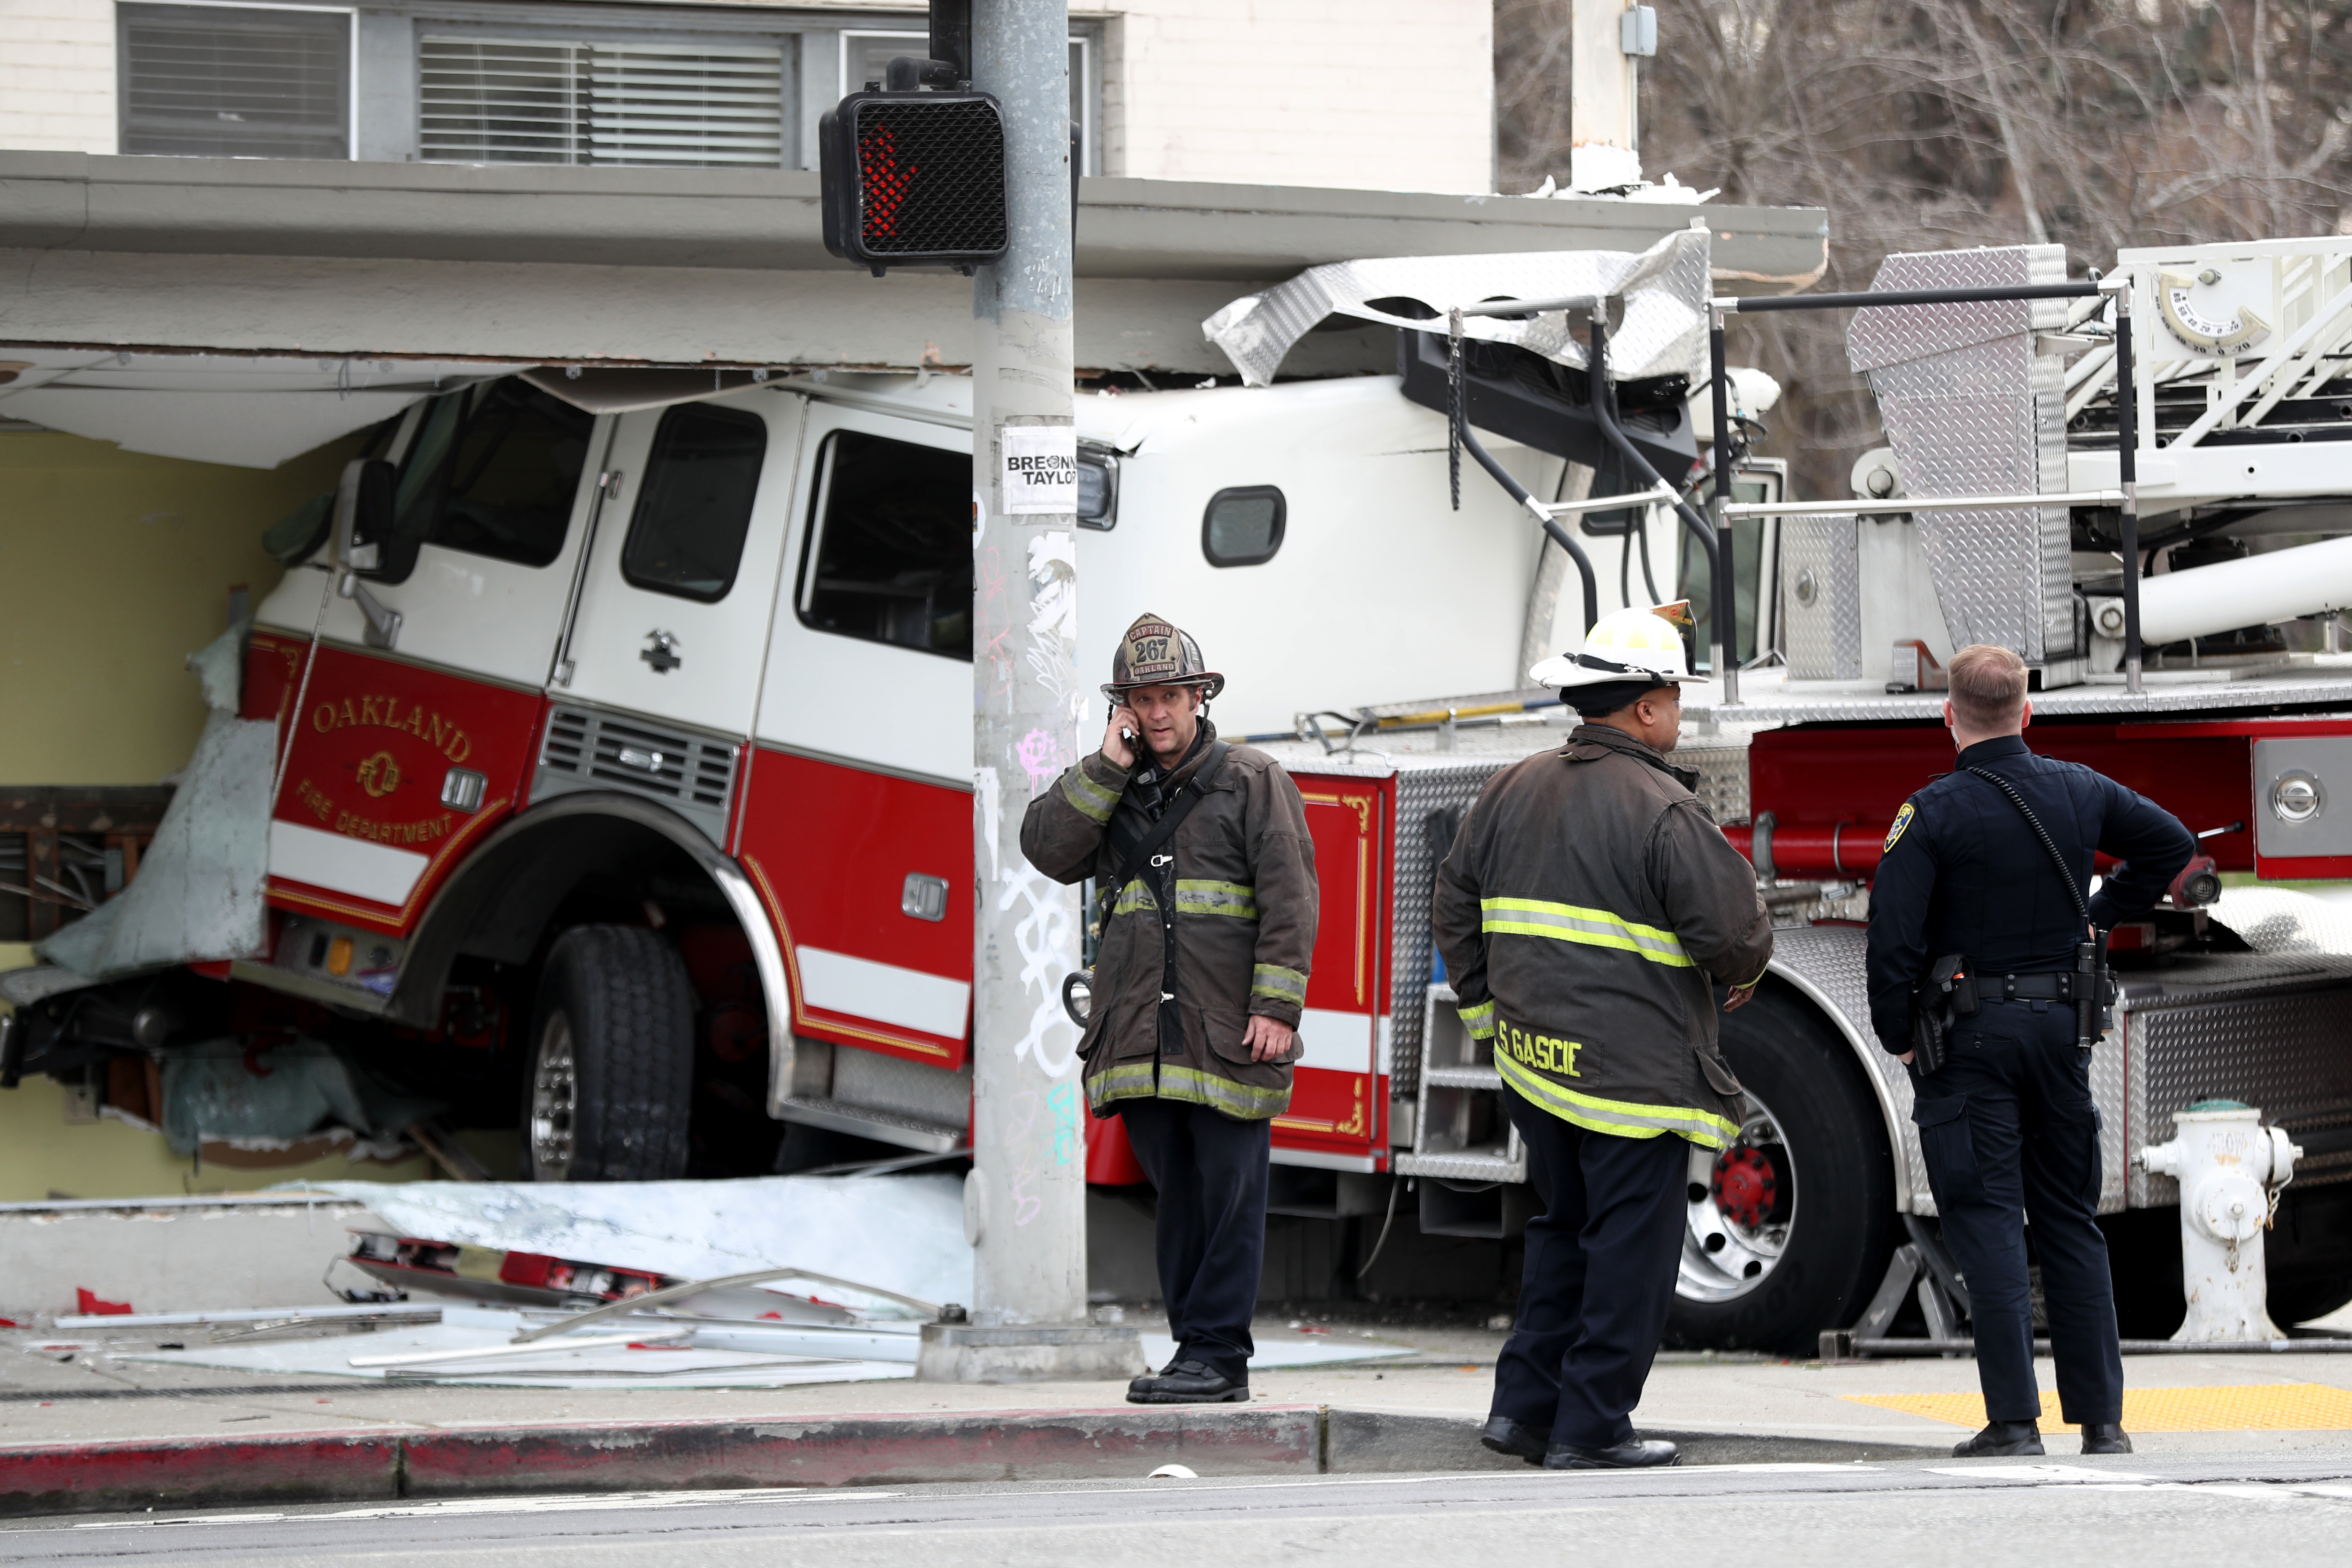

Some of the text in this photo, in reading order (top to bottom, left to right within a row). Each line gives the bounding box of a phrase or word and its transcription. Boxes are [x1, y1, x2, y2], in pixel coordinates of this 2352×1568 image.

[2162, 316, 2171, 330] 60
[1008, 456, 1076, 470] BREONN
[1022, 471, 1076, 485] TAYLOR
[1130, 626, 1172, 640] CAPTAIN
[1135, 639, 1168, 663] 267
[1134, 663, 1174, 675] OAKLAND
[313, 695, 471, 763] OAKLAND
[297, 779, 333, 821] FIRE
[335, 810, 453, 844] DEPARTMENT
[1499, 1019, 1582, 1078] S GASCIE
